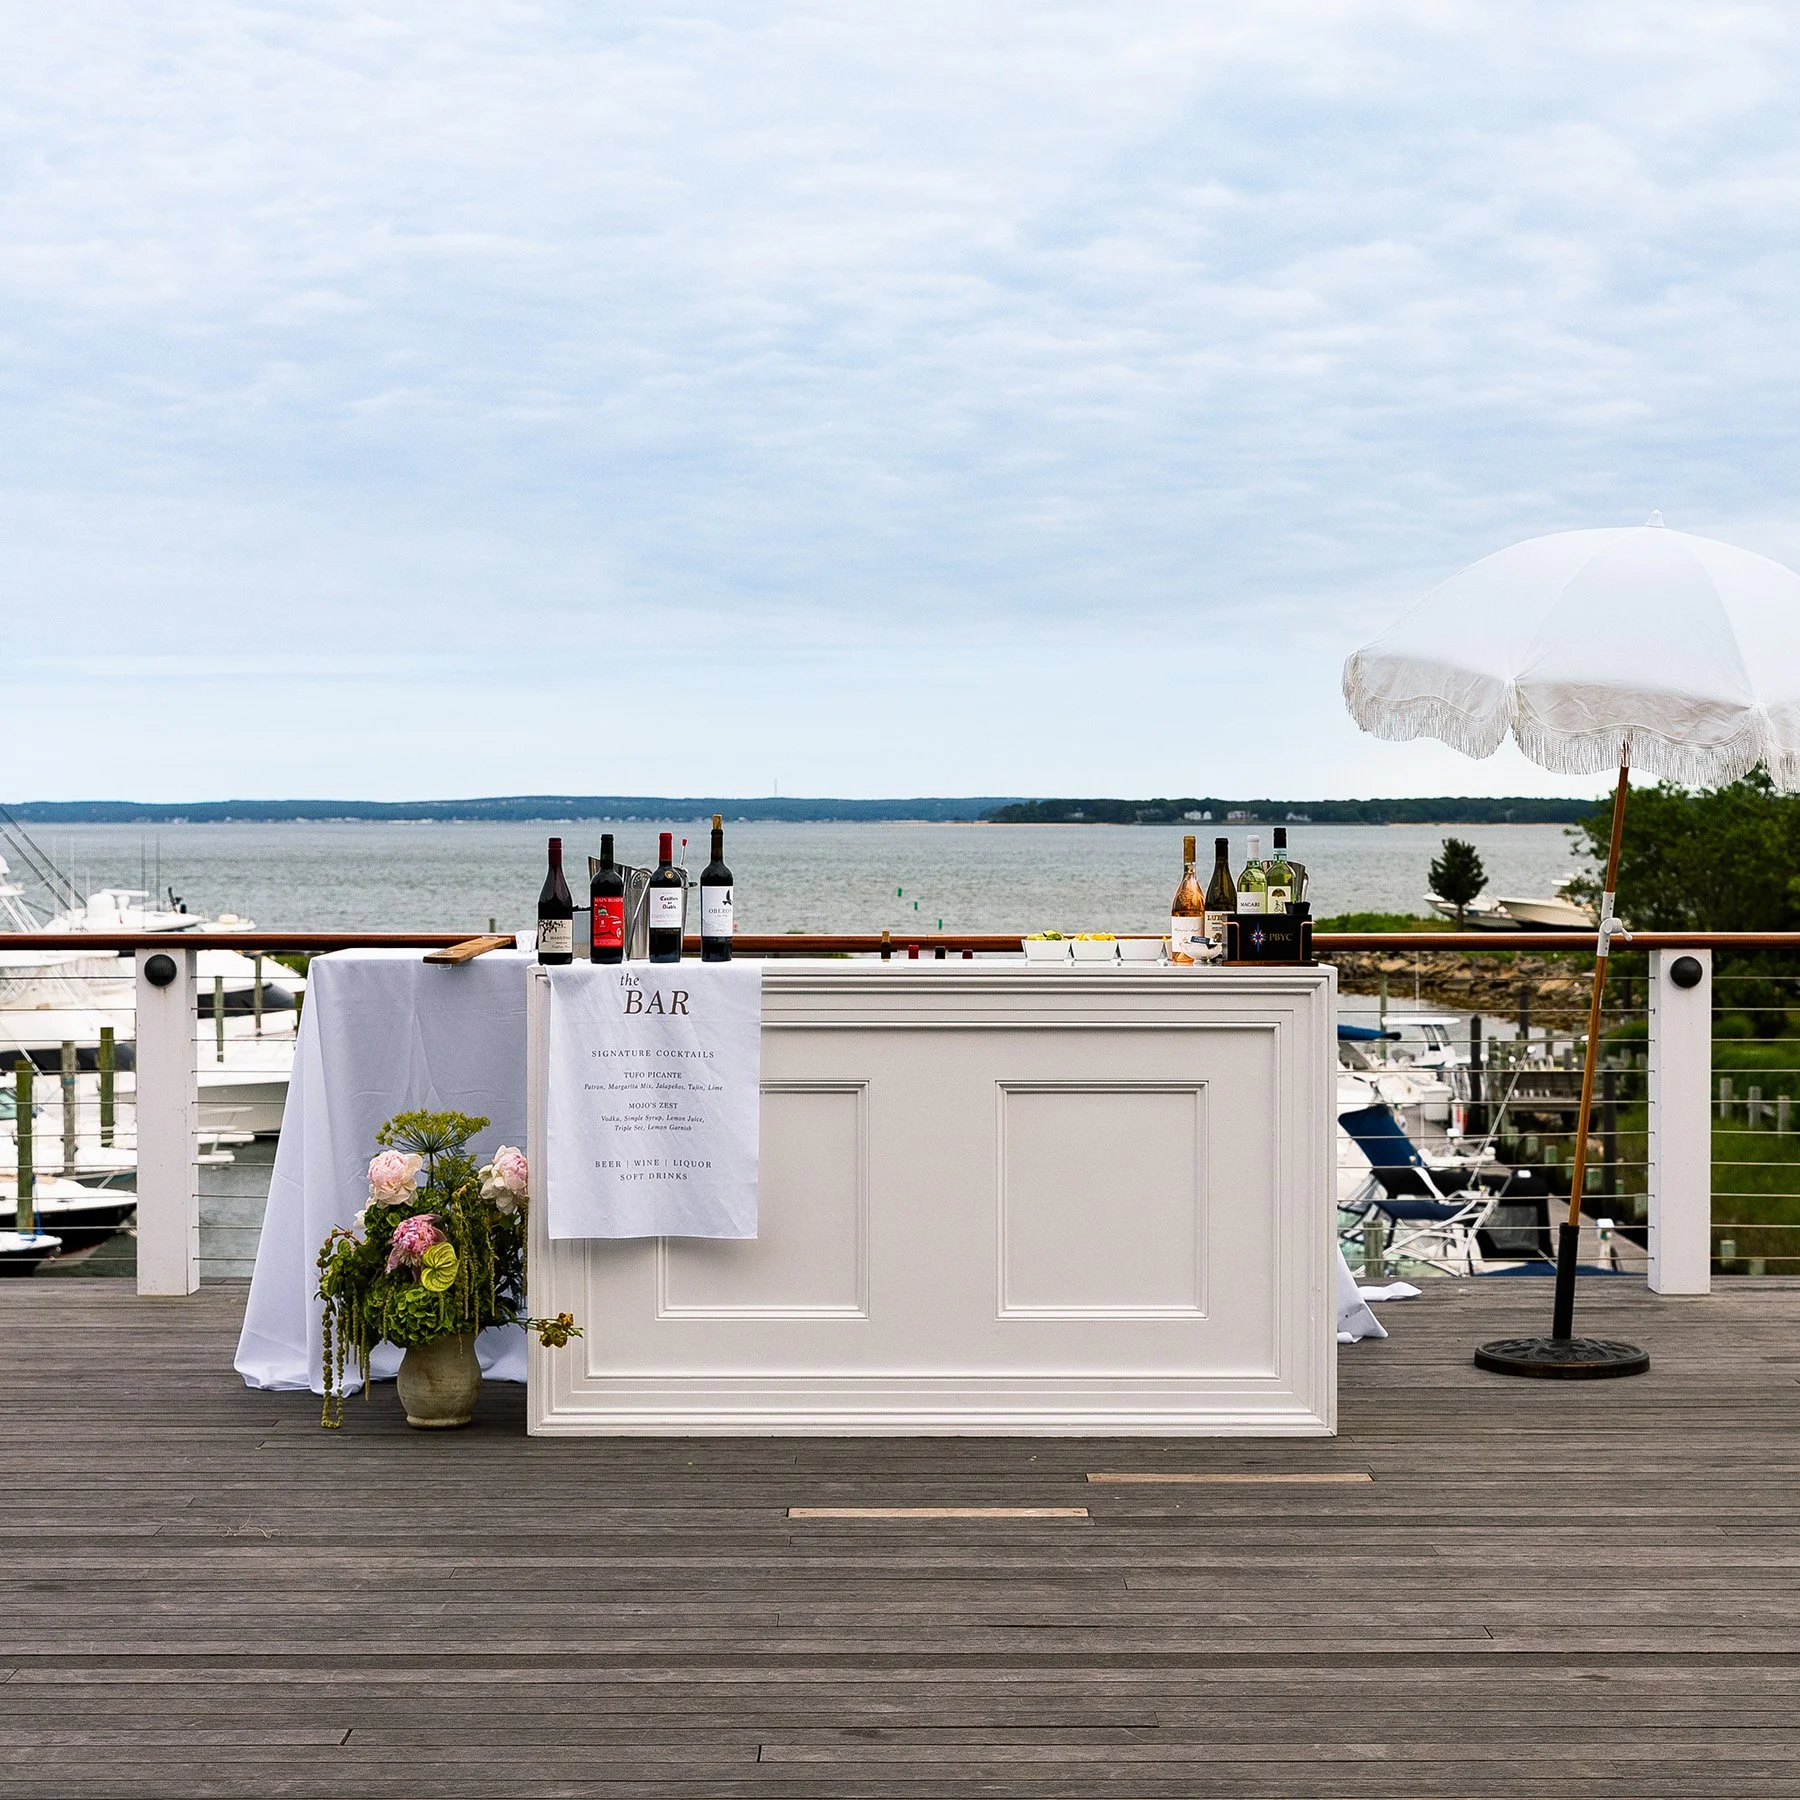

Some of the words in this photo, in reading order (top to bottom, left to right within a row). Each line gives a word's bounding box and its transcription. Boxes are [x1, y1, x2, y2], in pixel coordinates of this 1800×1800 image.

[1269, 932, 1293, 941] PBYC
[620, 973, 640, 986] the
[623, 989, 690, 1016] BAR
[591, 1049, 652, 1058] SIGNATURE
[656, 1049, 715, 1059] COCKTAILS
[623, 1071, 645, 1079] TUFO
[647, 1071, 683, 1079] PICANTE
[608, 1083, 638, 1091] Margarita
[628, 1102, 657, 1110] MOJO'S
[614, 1124, 632, 1132] Triple
[647, 1123, 668, 1131] Lemon
[669, 1123, 693, 1131] Garnish
[595, 1160, 622, 1168] BEER
[633, 1158, 660, 1167] WINE
[673, 1159, 712, 1169] LIQUOR
[620, 1173, 644, 1181] SOFT
[648, 1172, 688, 1181] DRINKS
